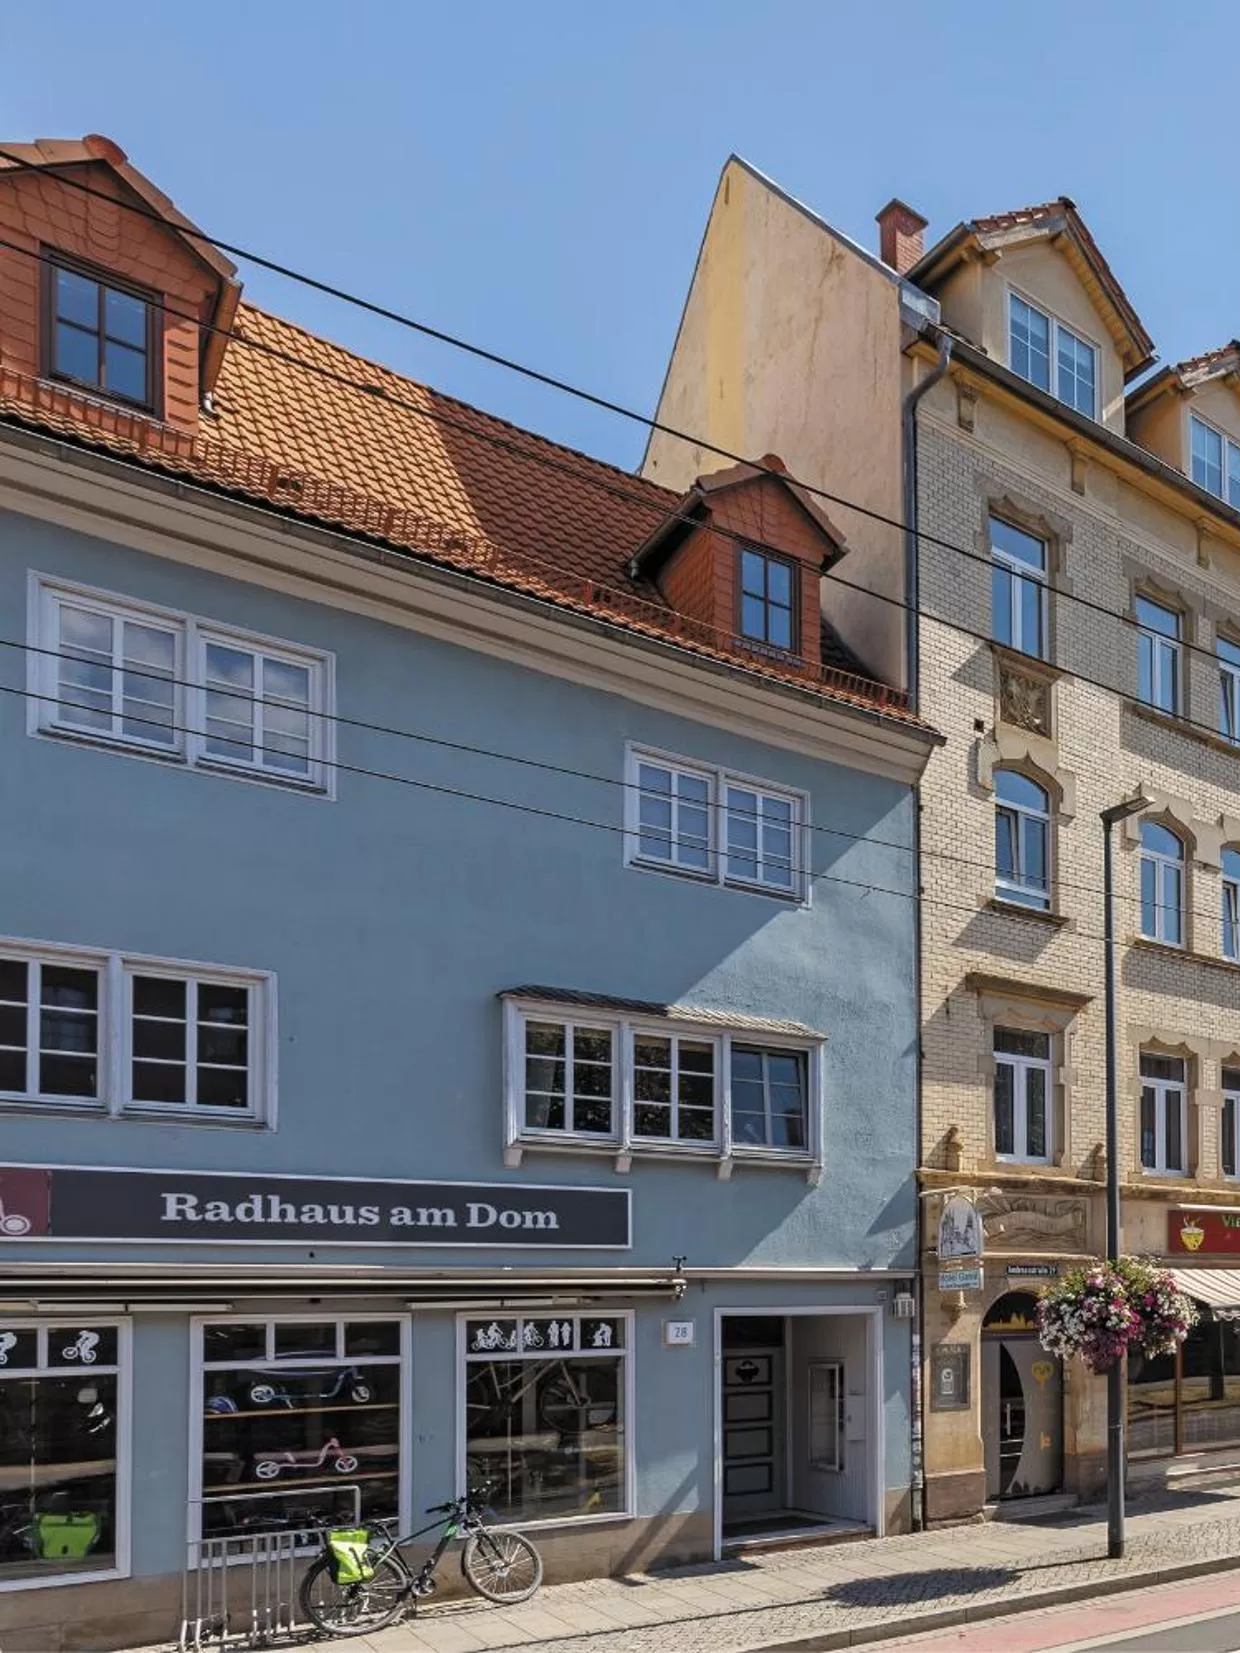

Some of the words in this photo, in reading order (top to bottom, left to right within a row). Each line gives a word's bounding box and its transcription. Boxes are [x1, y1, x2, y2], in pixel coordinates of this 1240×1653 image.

[160, 1192, 381, 1225] Radhaus
[389, 1206, 458, 1227] am
[465, 1203, 560, 1229] Dom
